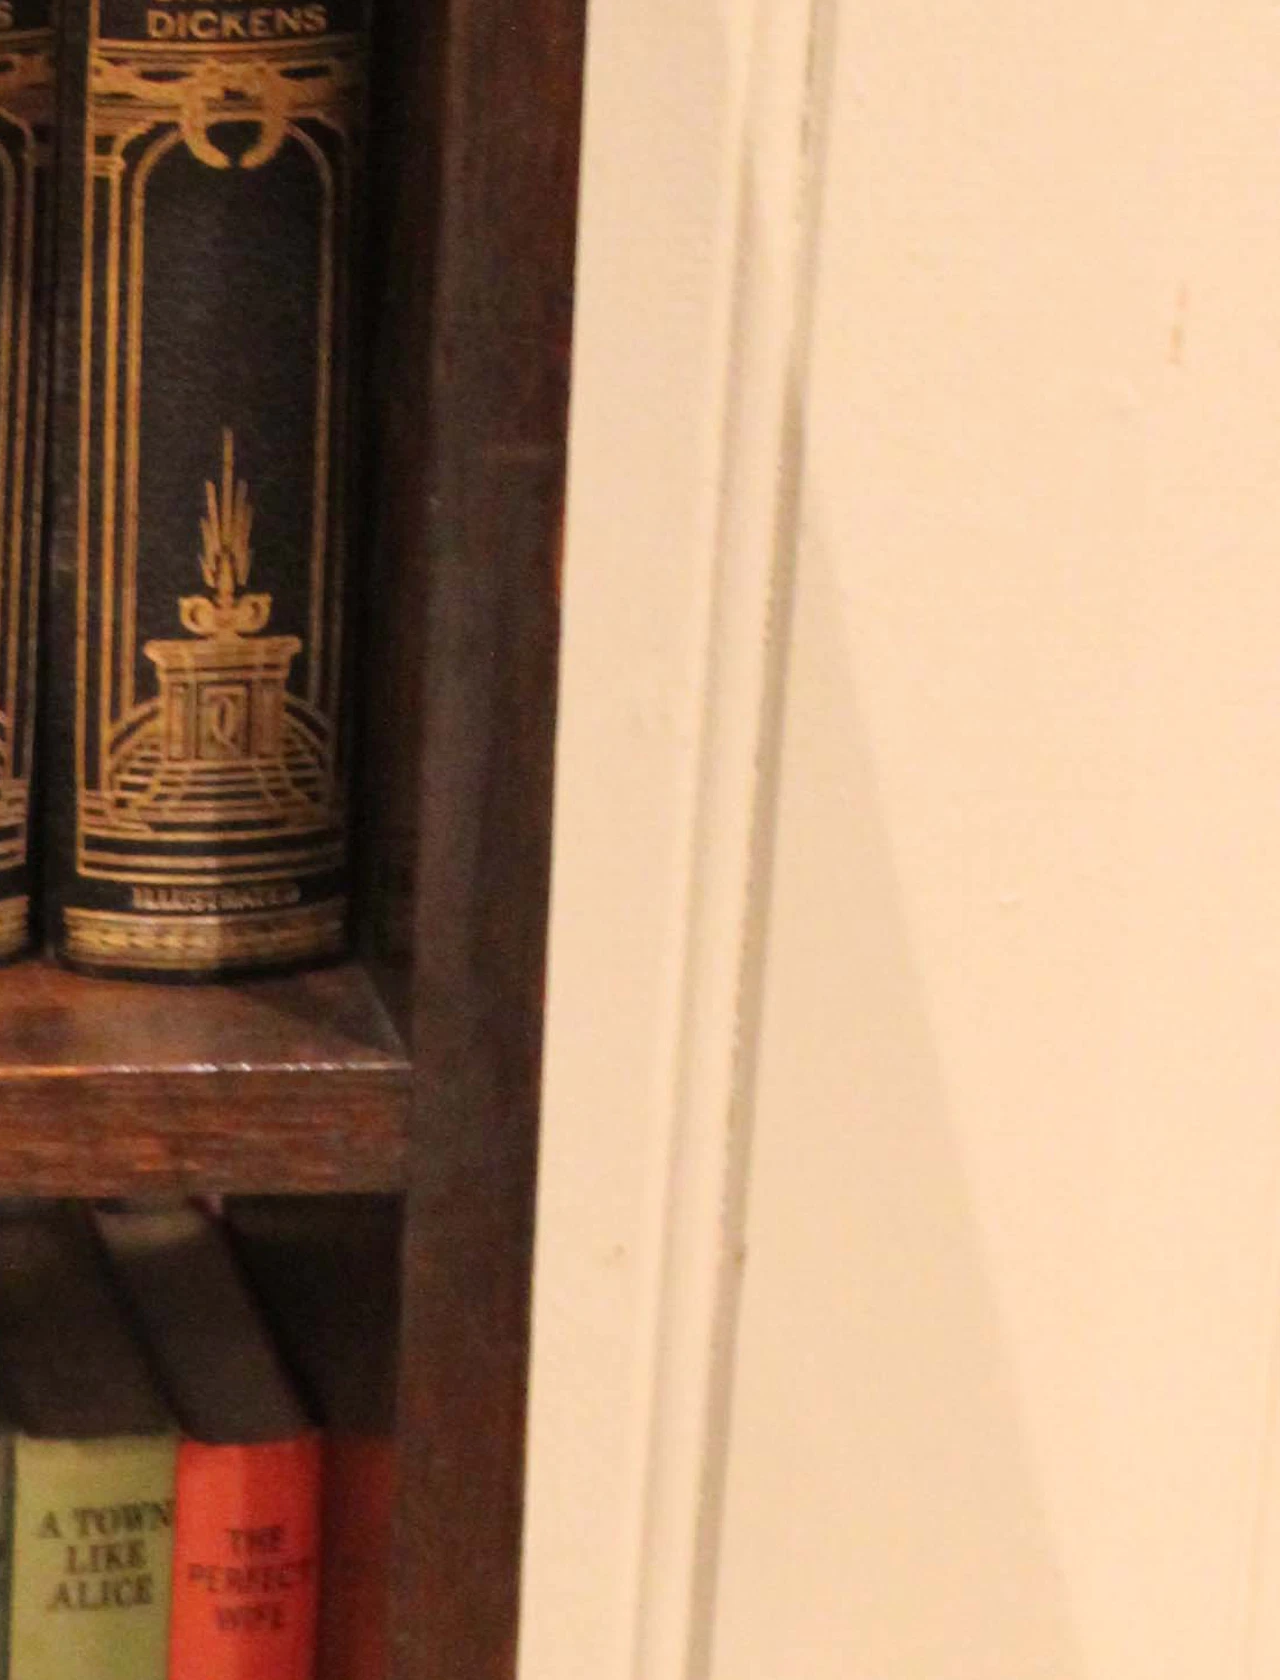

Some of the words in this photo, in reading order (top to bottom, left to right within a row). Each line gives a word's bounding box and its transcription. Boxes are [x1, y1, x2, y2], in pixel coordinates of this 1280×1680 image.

[146, 3, 328, 41] DICKENS
[37, 1509, 62, 1540] A
[72, 1499, 176, 1537] TOWN
[65, 1539, 148, 1575] LIKE
[227, 1525, 283, 1554] THE
[47, 1574, 153, 1612] ALICE
[215, 1603, 283, 1633] WIFE
